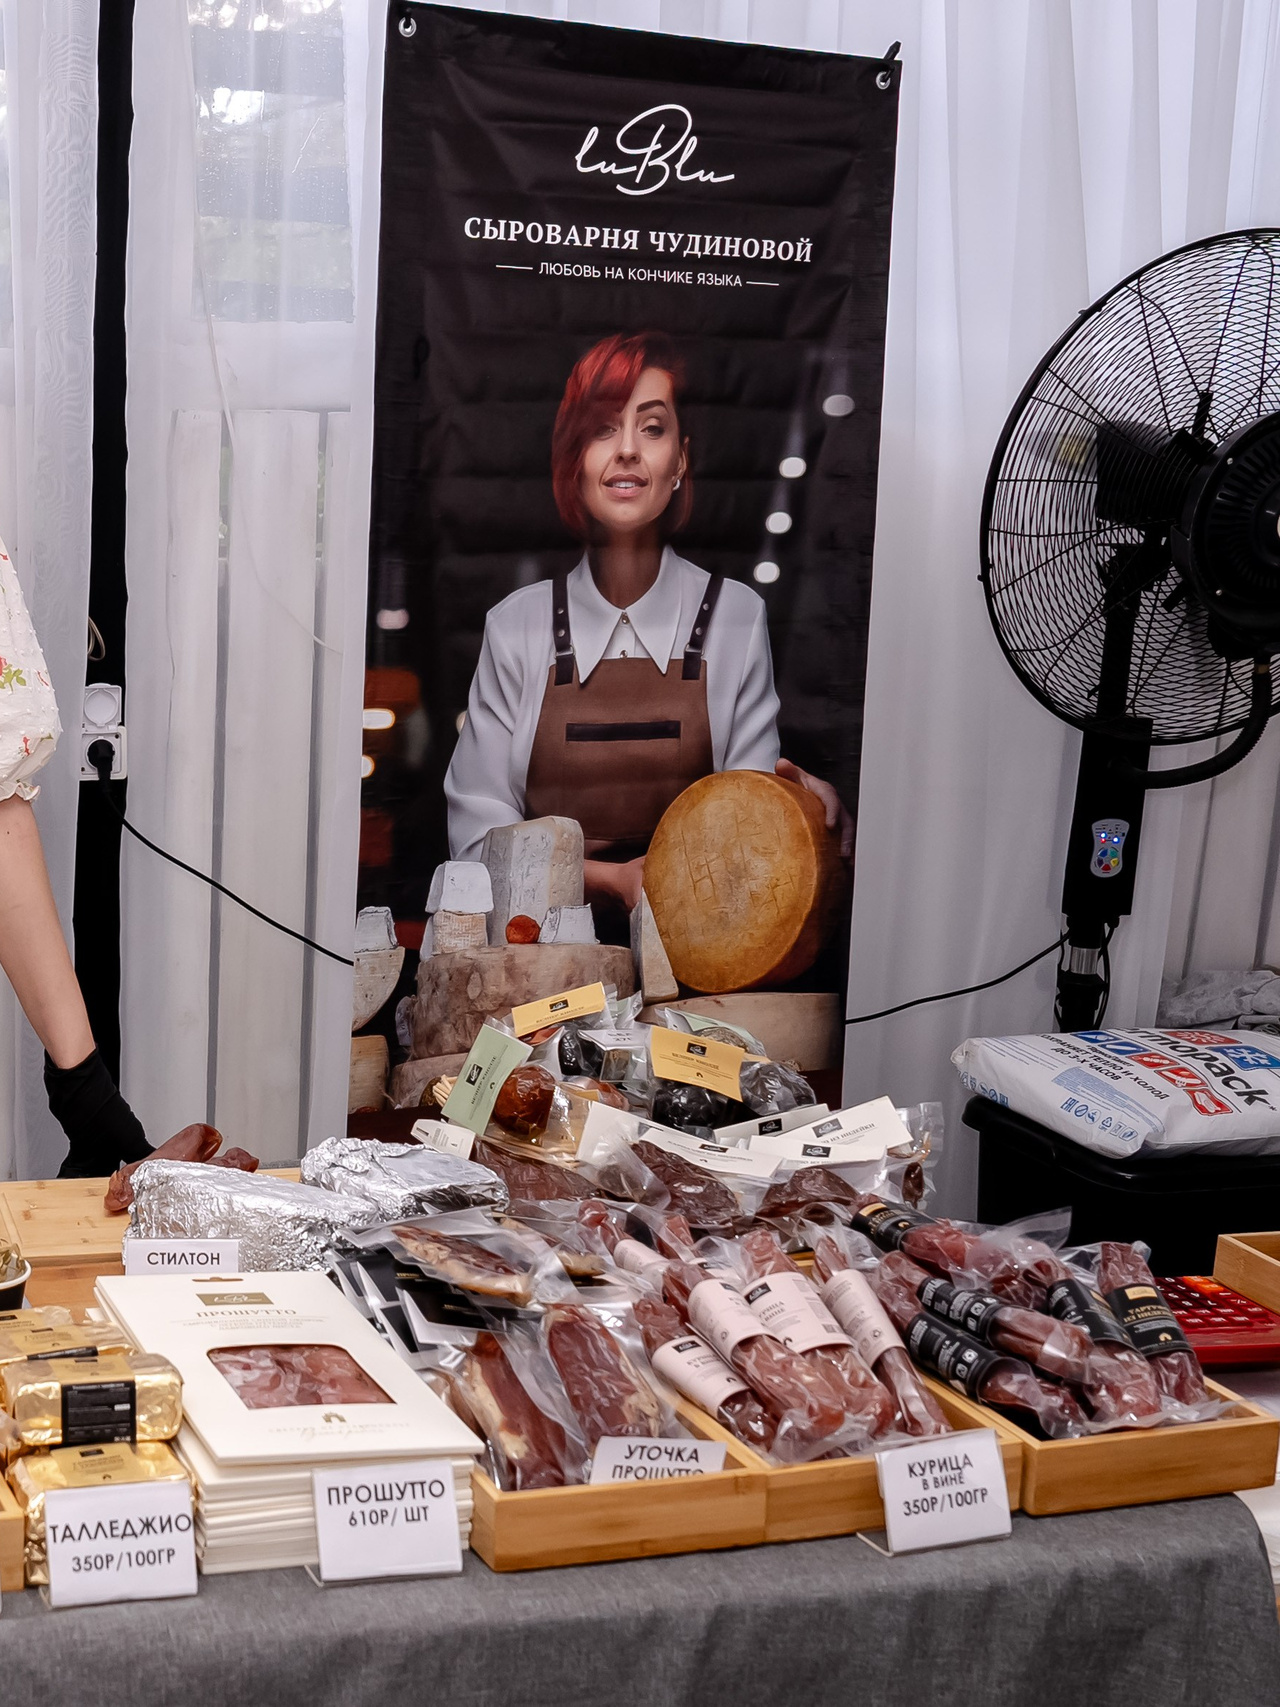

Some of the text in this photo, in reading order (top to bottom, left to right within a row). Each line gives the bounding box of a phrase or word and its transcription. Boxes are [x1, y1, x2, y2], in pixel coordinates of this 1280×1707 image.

[464, 216, 813, 263] СЫРОВАРНЯ ЧУДИНОВОЙ
[538, 262, 743, 287] ЛЮБОВЬ НА КОНЧИКЕ ЯЗЫКА
[1089, 1054, 1124, 1074] ТЕПЛО
[1089, 1062, 1123, 1081] ЧАСОВ
[146, 1252, 220, 1266] СТИЛТОН
[624, 1444, 700, 1464] УТОЧКА
[907, 1453, 974, 1479] КУРИЦА
[326, 1479, 446, 1507] ПРОШУТТО
[921, 1471, 966, 1491] В ВИНЕ
[902, 1487, 989, 1517] 350Р/100ГР
[48, 1512, 193, 1544] ТАЛЛЕДЖИО
[348, 1504, 430, 1527] 610Р/ ШТ
[71, 1547, 177, 1573] 350Р/100ГР
